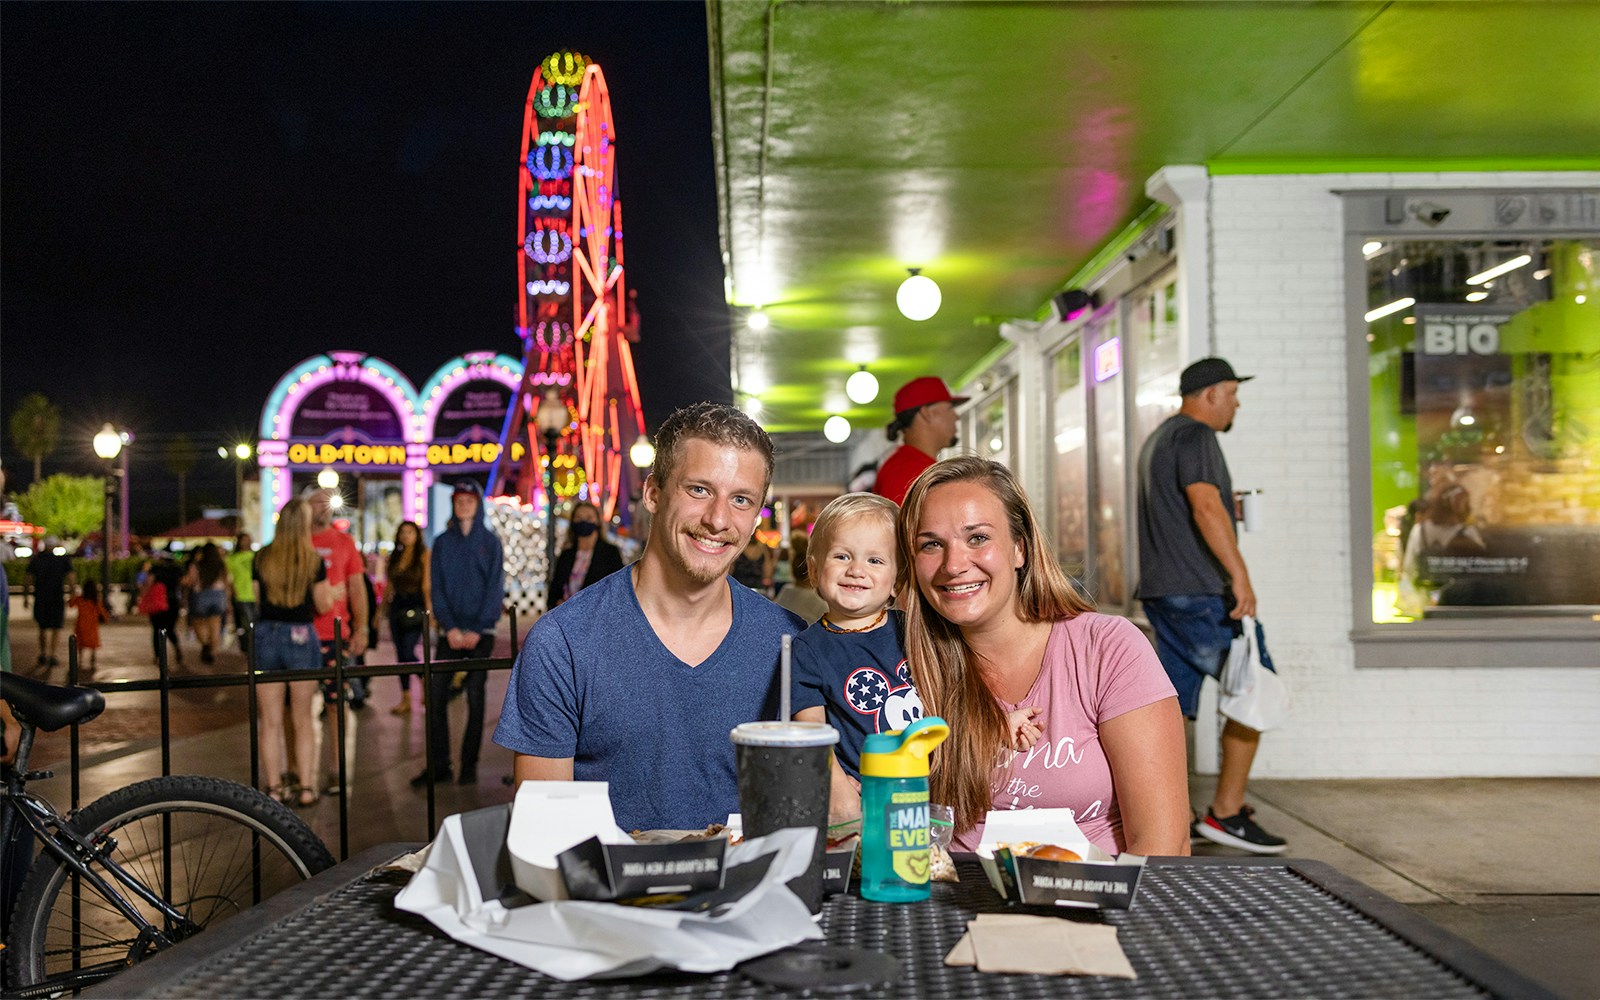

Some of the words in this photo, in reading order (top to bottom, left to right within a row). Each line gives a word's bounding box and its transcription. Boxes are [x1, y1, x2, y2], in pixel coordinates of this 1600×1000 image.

[1007, 777, 1042, 798] the
[622, 862, 645, 877] YORK
[645, 861, 664, 875] NEW
[664, 861, 675, 875] OF
[675, 859, 704, 874] FLAVOR
[704, 858, 719, 872] THE
[827, 867, 841, 880] THE
[1033, 874, 1054, 888] YORK
[1054, 877, 1073, 890] NEW
[1073, 879, 1083, 891] OF
[1083, 880, 1113, 893] FLAVOR
[1113, 881, 1128, 894] THE
[20, 984, 64, 998] SHIMANO
